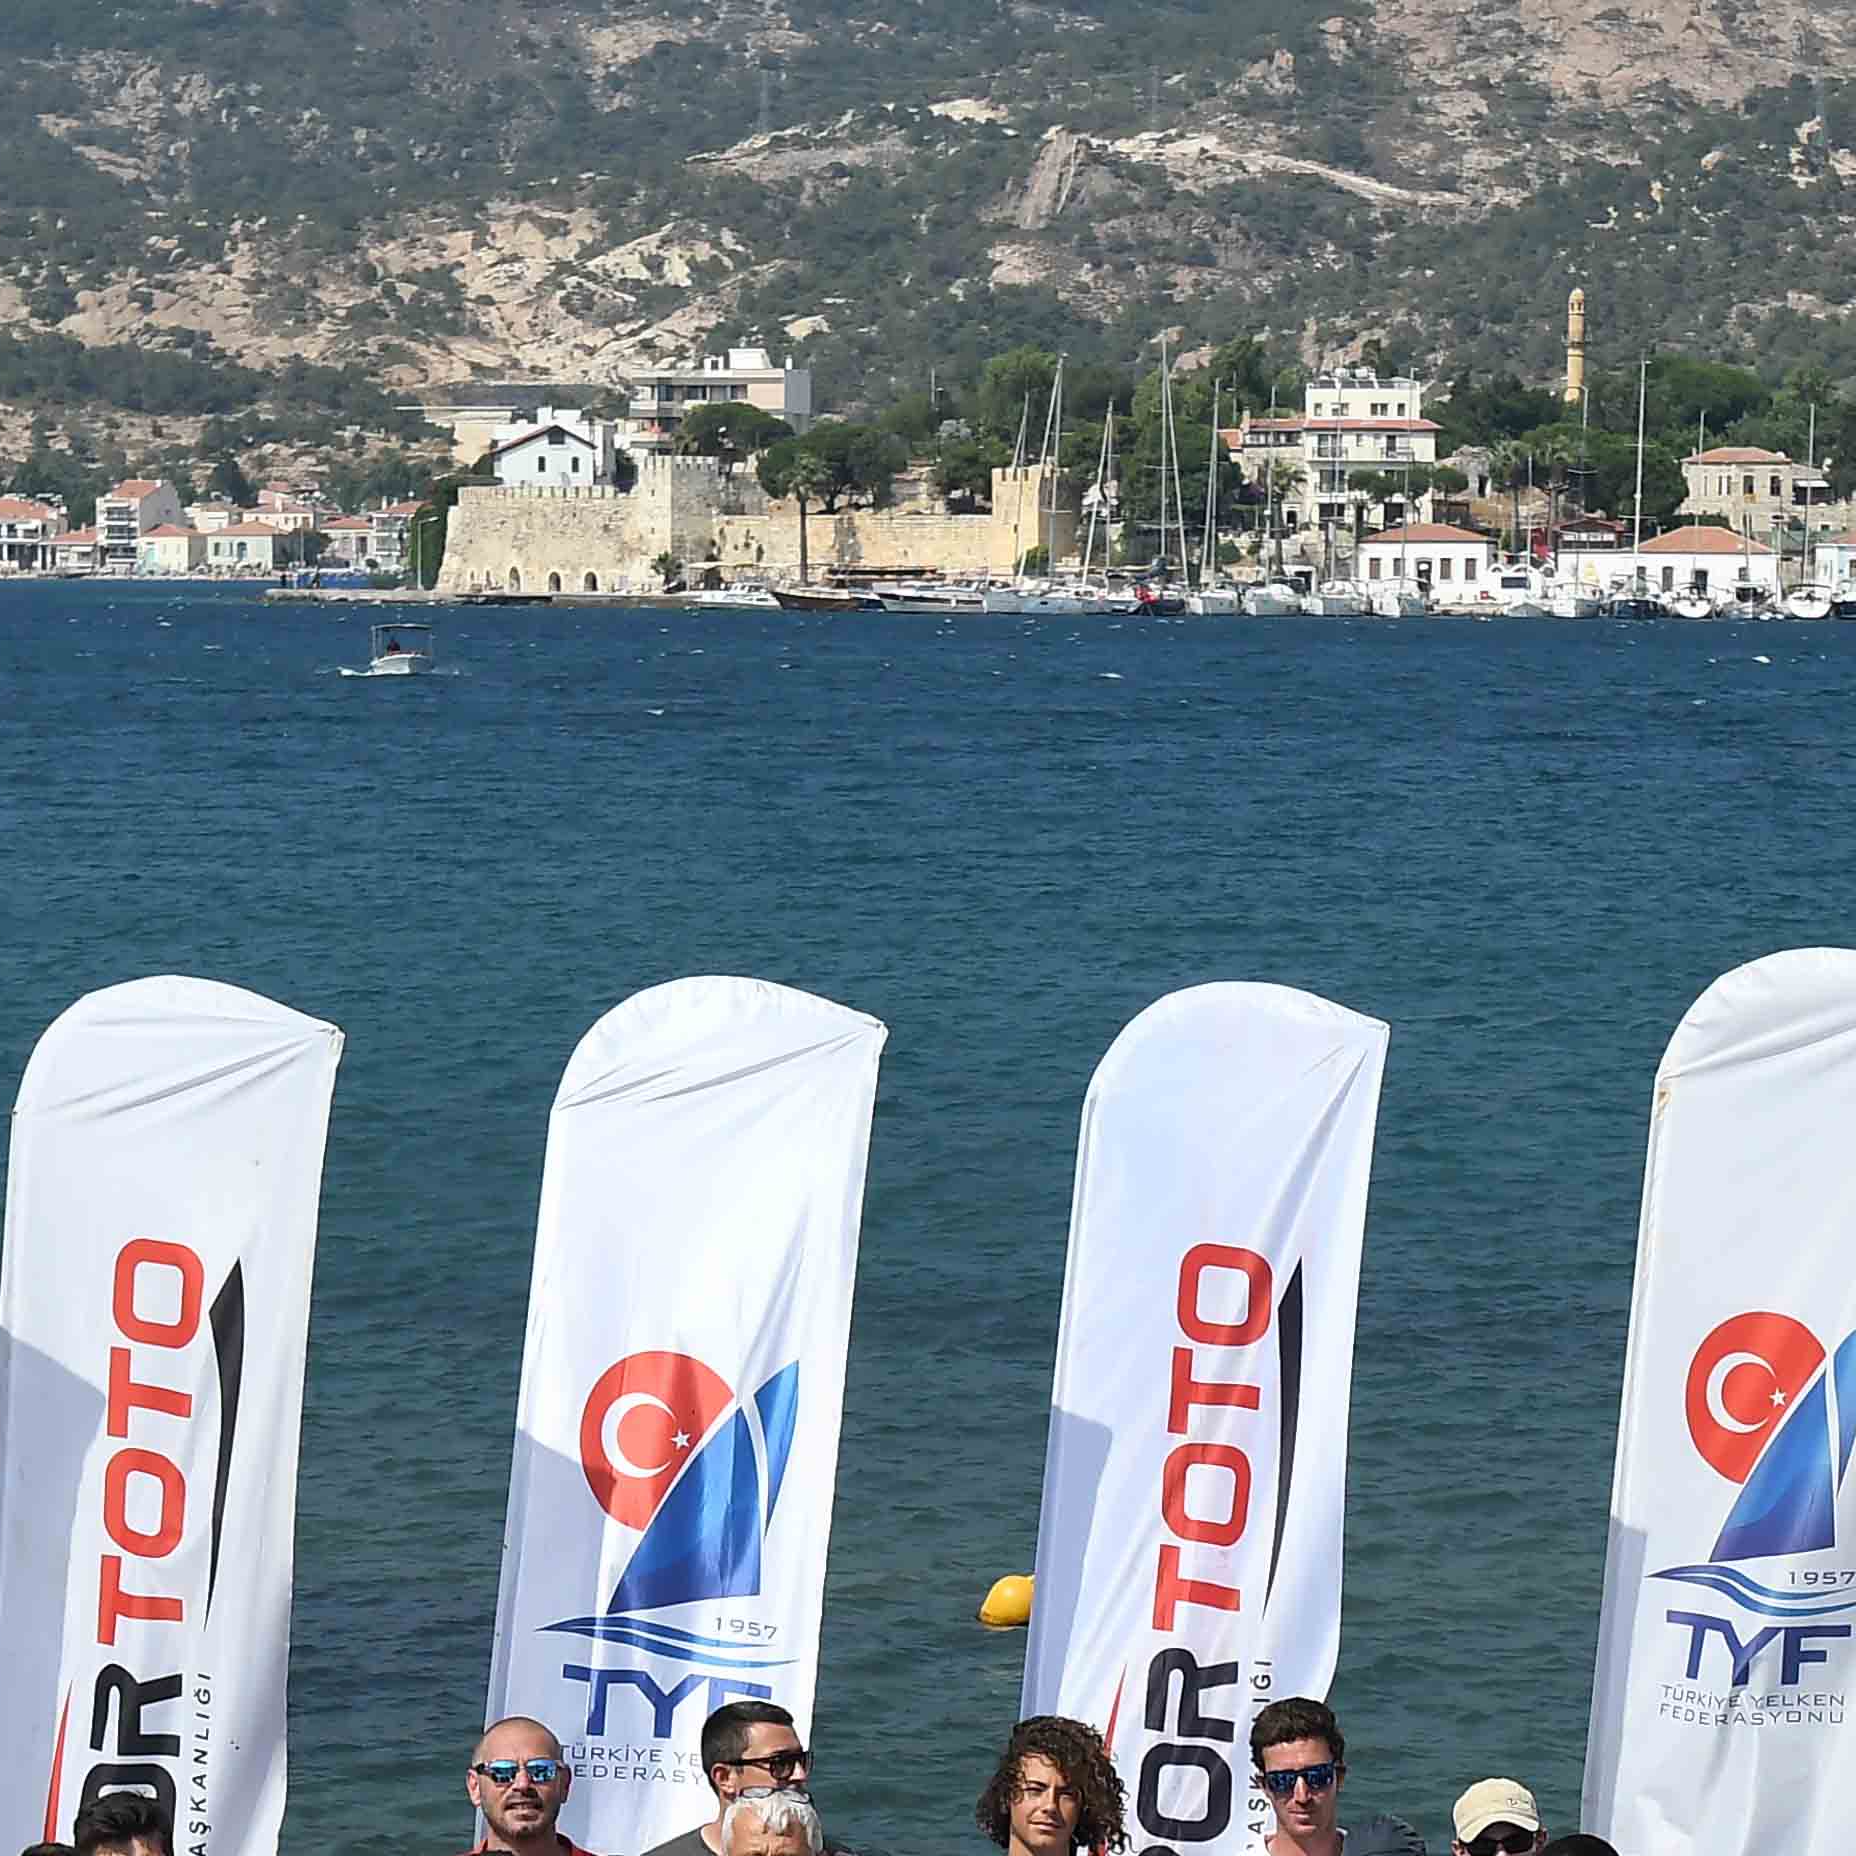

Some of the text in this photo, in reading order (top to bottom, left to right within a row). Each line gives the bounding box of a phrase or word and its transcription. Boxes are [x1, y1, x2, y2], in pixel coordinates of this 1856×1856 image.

[97, 1237, 204, 1646] TOTO
[1151, 1242, 1273, 1634] TOTO
[1788, 1570, 1856, 1586] 1957
[714, 1616, 779, 1641] 1957
[1666, 1609, 1852, 1687] TYF
[1661, 1684, 1846, 1709] TÜRKİYE YELKEN
[1658, 1703, 1845, 1726] FEDERASYONU
